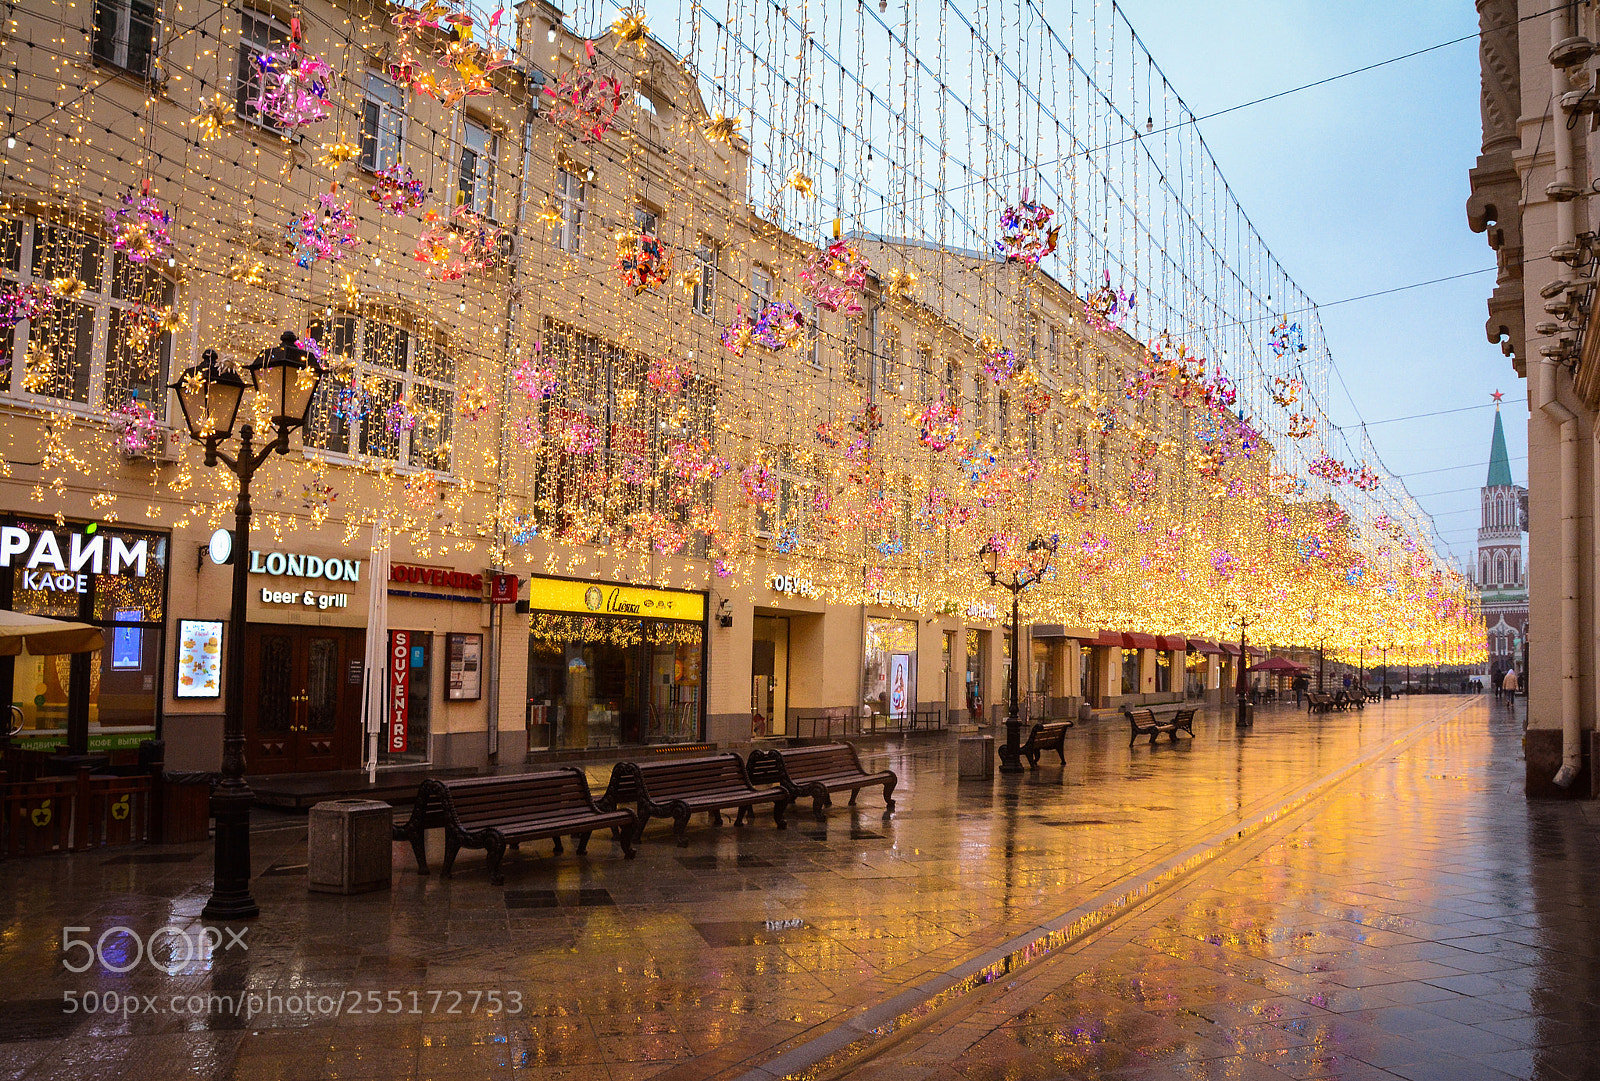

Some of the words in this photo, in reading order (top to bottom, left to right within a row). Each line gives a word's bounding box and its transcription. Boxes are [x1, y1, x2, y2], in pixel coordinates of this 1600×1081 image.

[249, 550, 361, 582] LONDON
[23, 570, 88, 593] КАФЕ
[262, 587, 299, 604] beer
[303, 590, 315, 606] &
[318, 593, 348, 610] grill
[393, 633, 407, 749] SOUVENIRS
[20, 740, 62, 751] АНДВИЧИ
[89, 738, 112, 747] КОФЕ
